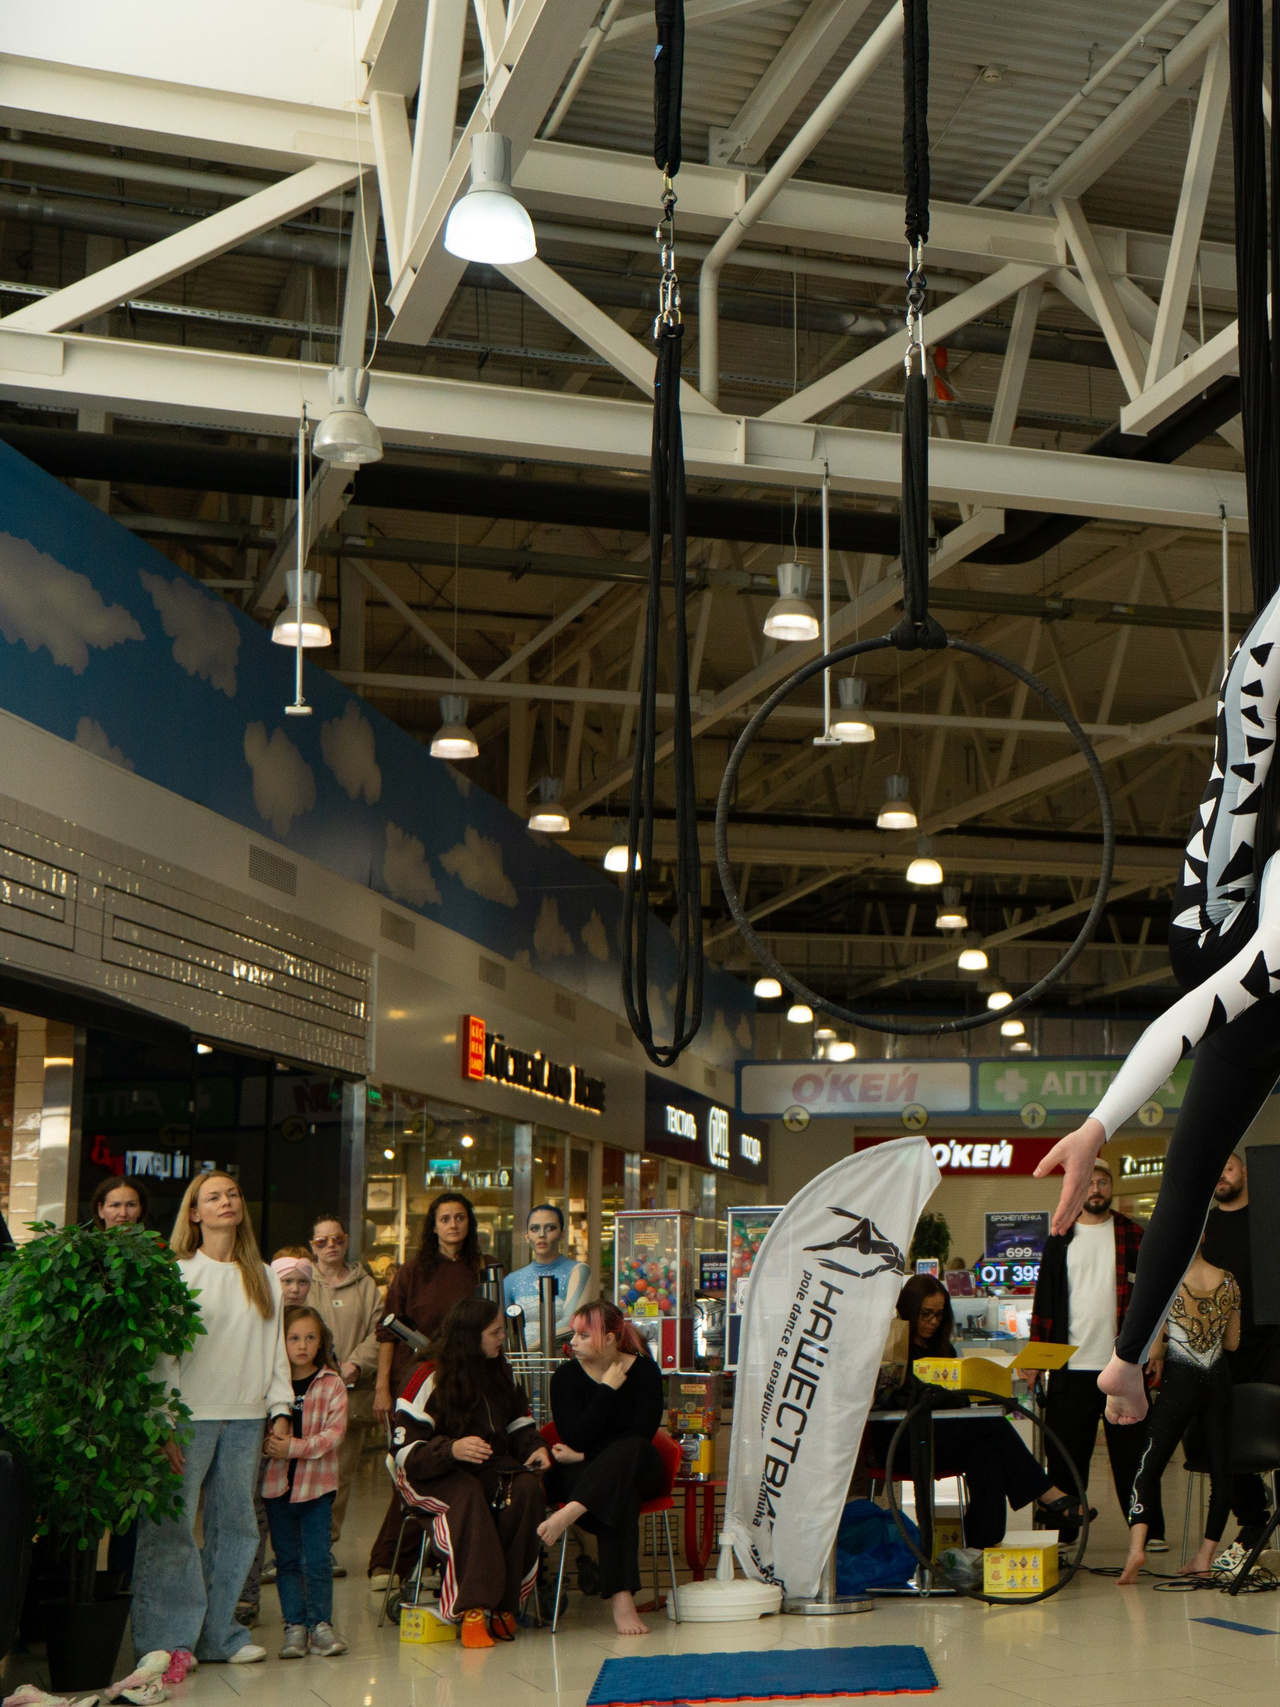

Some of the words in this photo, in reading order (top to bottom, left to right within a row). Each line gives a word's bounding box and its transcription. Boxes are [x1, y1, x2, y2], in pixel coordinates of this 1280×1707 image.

[1006, 1247, 1032, 1258] 699
[981, 1266, 1008, 1282] ОТ
[796, 1269, 813, 1301] pole
[781, 1303, 802, 1345] dance
[393, 1426, 406, 1445] 3
